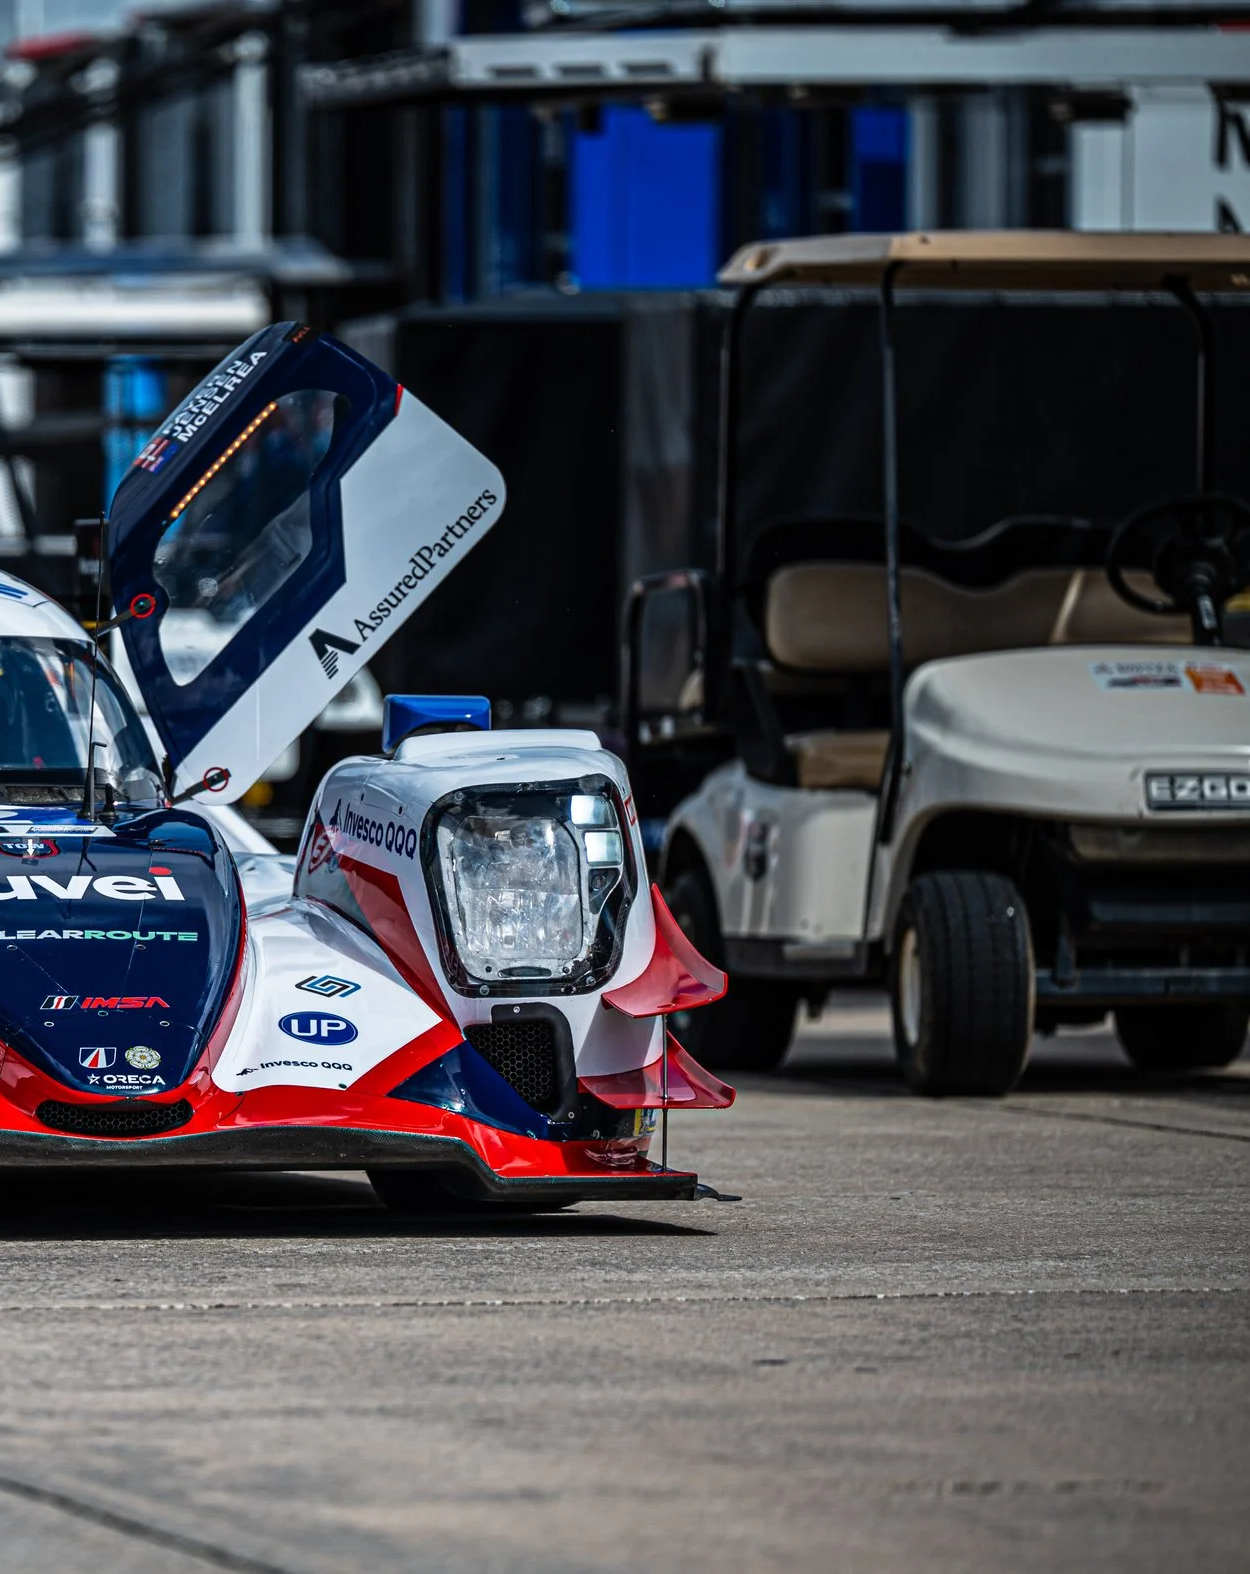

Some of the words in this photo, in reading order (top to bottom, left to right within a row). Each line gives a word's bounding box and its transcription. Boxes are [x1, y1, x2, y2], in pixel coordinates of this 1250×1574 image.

[177, 351, 268, 443] McELREA
[353, 489, 497, 643] AssuredPartners
[343, 803, 384, 847] Invesco
[385, 821, 417, 860] QQQ
[81, 996, 170, 1009] IMSA
[291, 1018, 347, 1037] UP
[260, 1060, 319, 1070] Invesco
[321, 1061, 353, 1071] QQQ
[103, 1074, 167, 1085] ORECA
